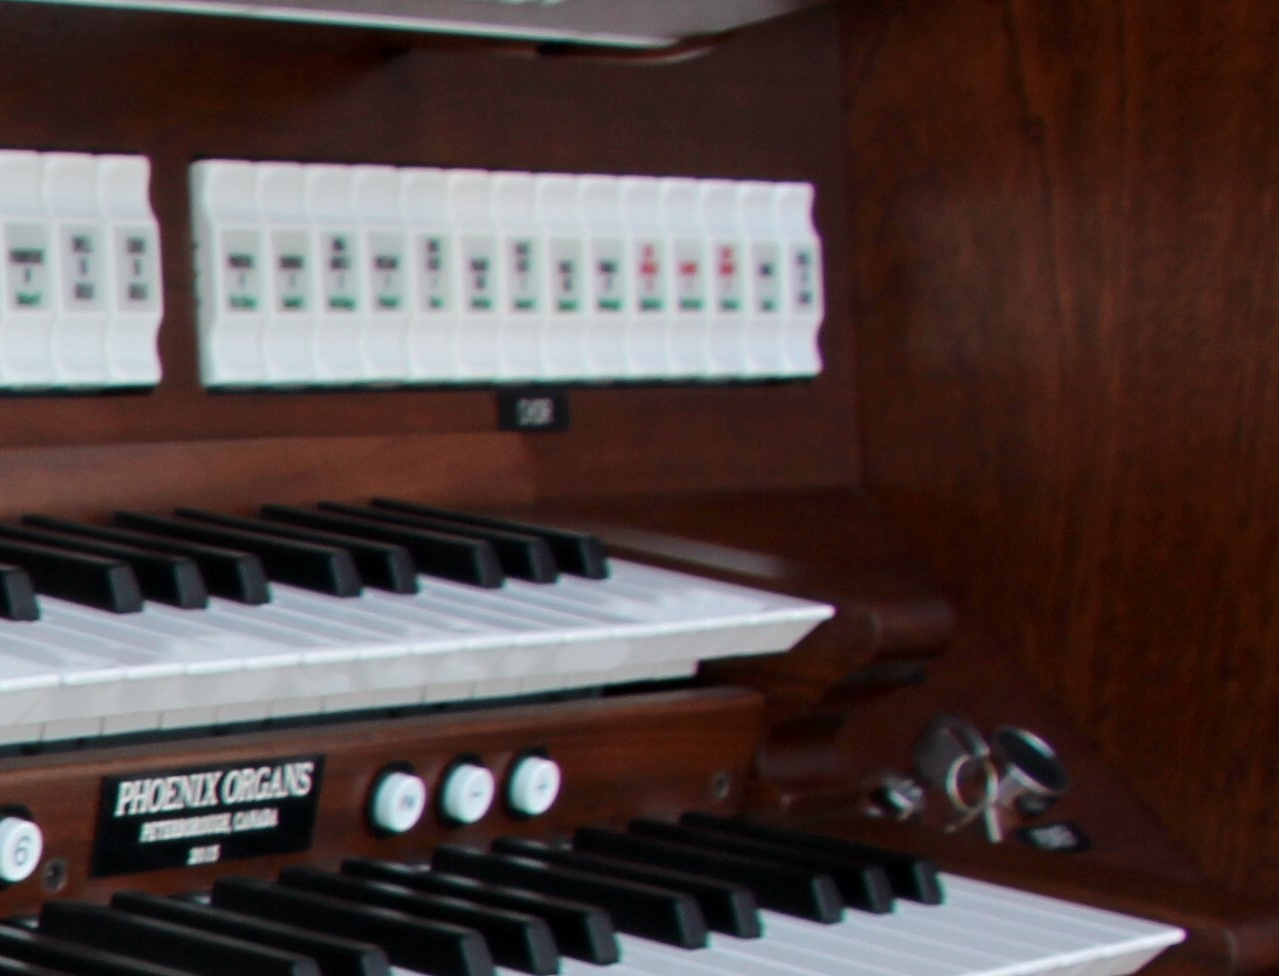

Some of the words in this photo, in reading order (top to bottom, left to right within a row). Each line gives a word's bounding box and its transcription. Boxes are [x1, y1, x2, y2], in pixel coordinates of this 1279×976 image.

[113, 771, 223, 817] PHOENIX
[221, 761, 315, 805] ORGANS
[14, 836, 32, 867] 6
